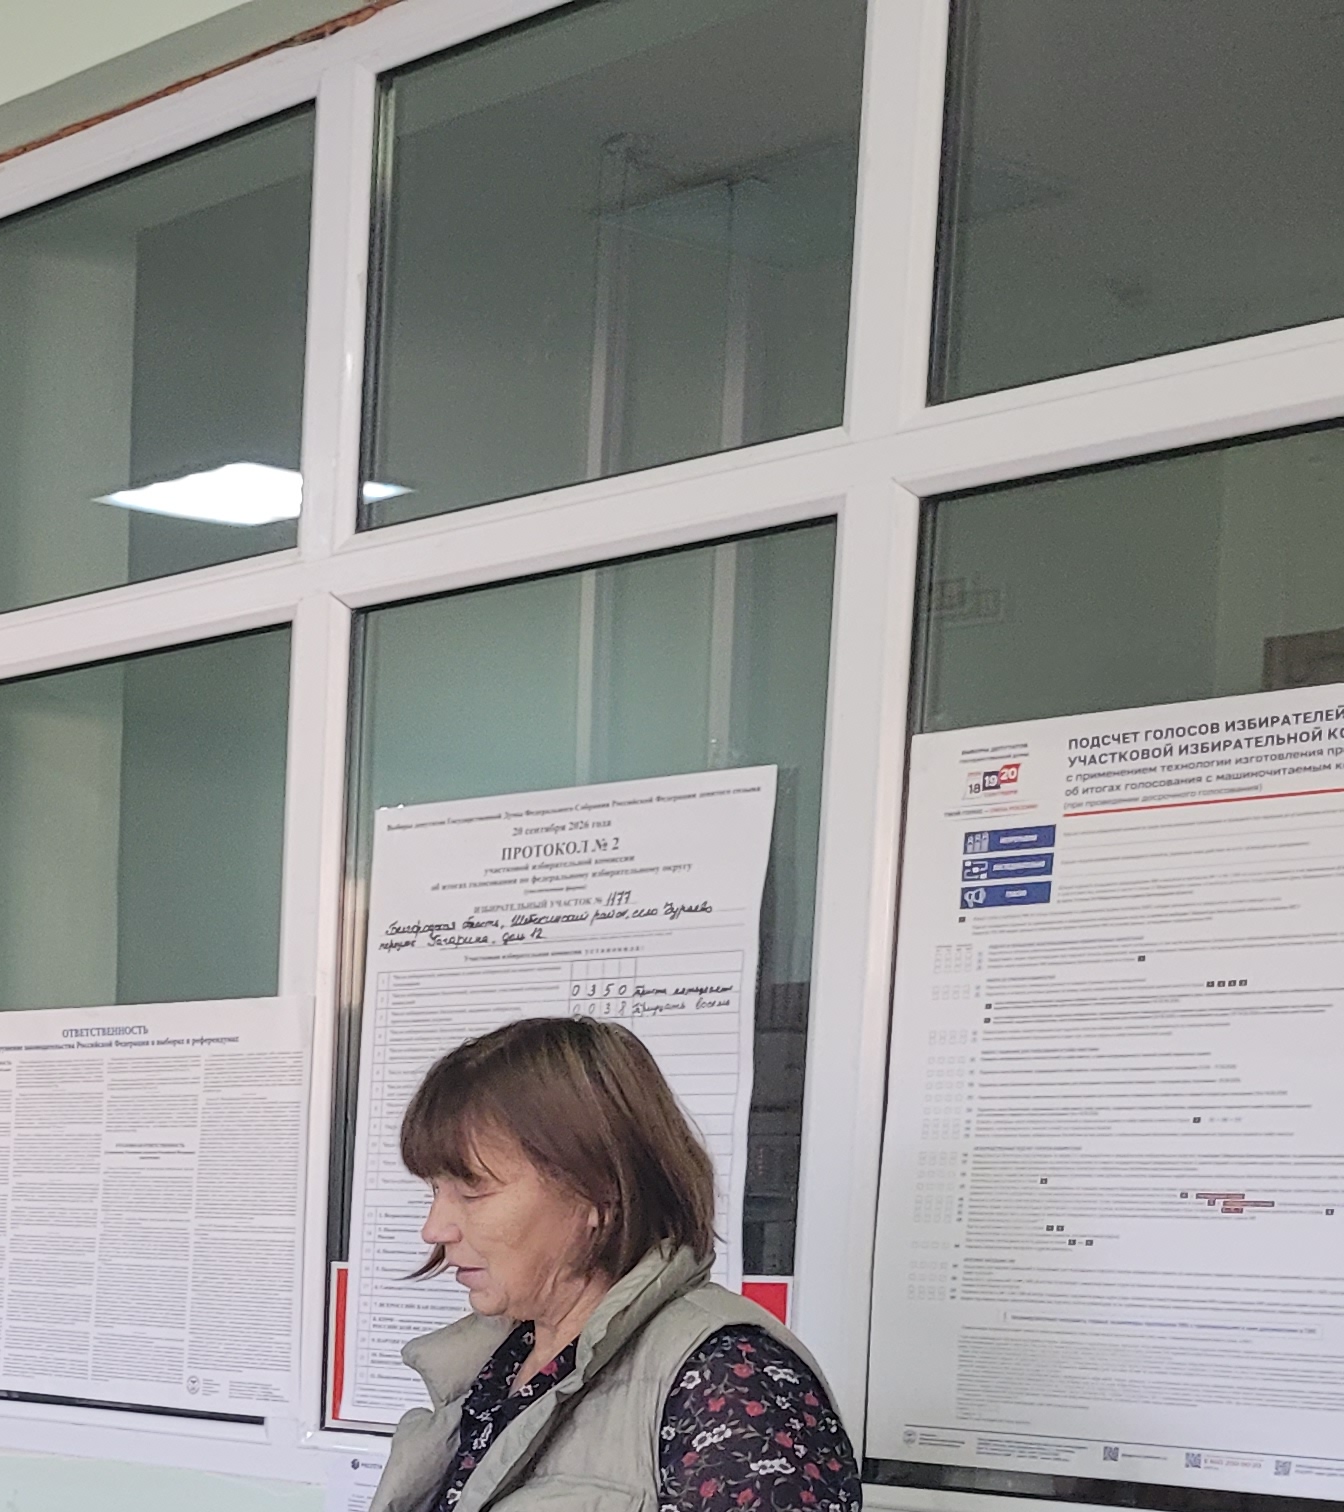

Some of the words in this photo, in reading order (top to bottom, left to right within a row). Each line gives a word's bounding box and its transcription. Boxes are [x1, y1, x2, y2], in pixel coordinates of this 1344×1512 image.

[1068, 731, 1140, 750] ПОДСЧЕТ
[1144, 722, 1220, 742] ГОЛОСОВ
[1225, 705, 1344, 732] ИЗБИРАТЕЛЕЙ
[1068, 743, 1173, 768] УЧАСТКОВОЙ
[1178, 727, 1323, 755] ИЗБИРАТЕЛЬНОЙ
[1065, 785, 1079, 796] об
[1082, 783, 1121, 796] итогах
[1124, 776, 1202, 792] голосования
[1216, 763, 1331, 783] машиночитаемым
[1076, 766, 1157, 783] применением
[1161, 758, 1231, 774] технологии
[1235, 749, 1324, 766] изготовления
[969, 783, 981, 794] 18
[984, 775, 998, 787] 19
[1000, 767, 1018, 780] 20
[525, 822, 566, 836] сентября
[501, 840, 589, 861] ПРОТОКОЛ
[591, 837, 608, 852] №
[612, 837, 620, 850] 2
[606, 890, 631, 907] 1177
[62, 1025, 149, 1038] ОТВЕТСТВЕННОСТЬ
